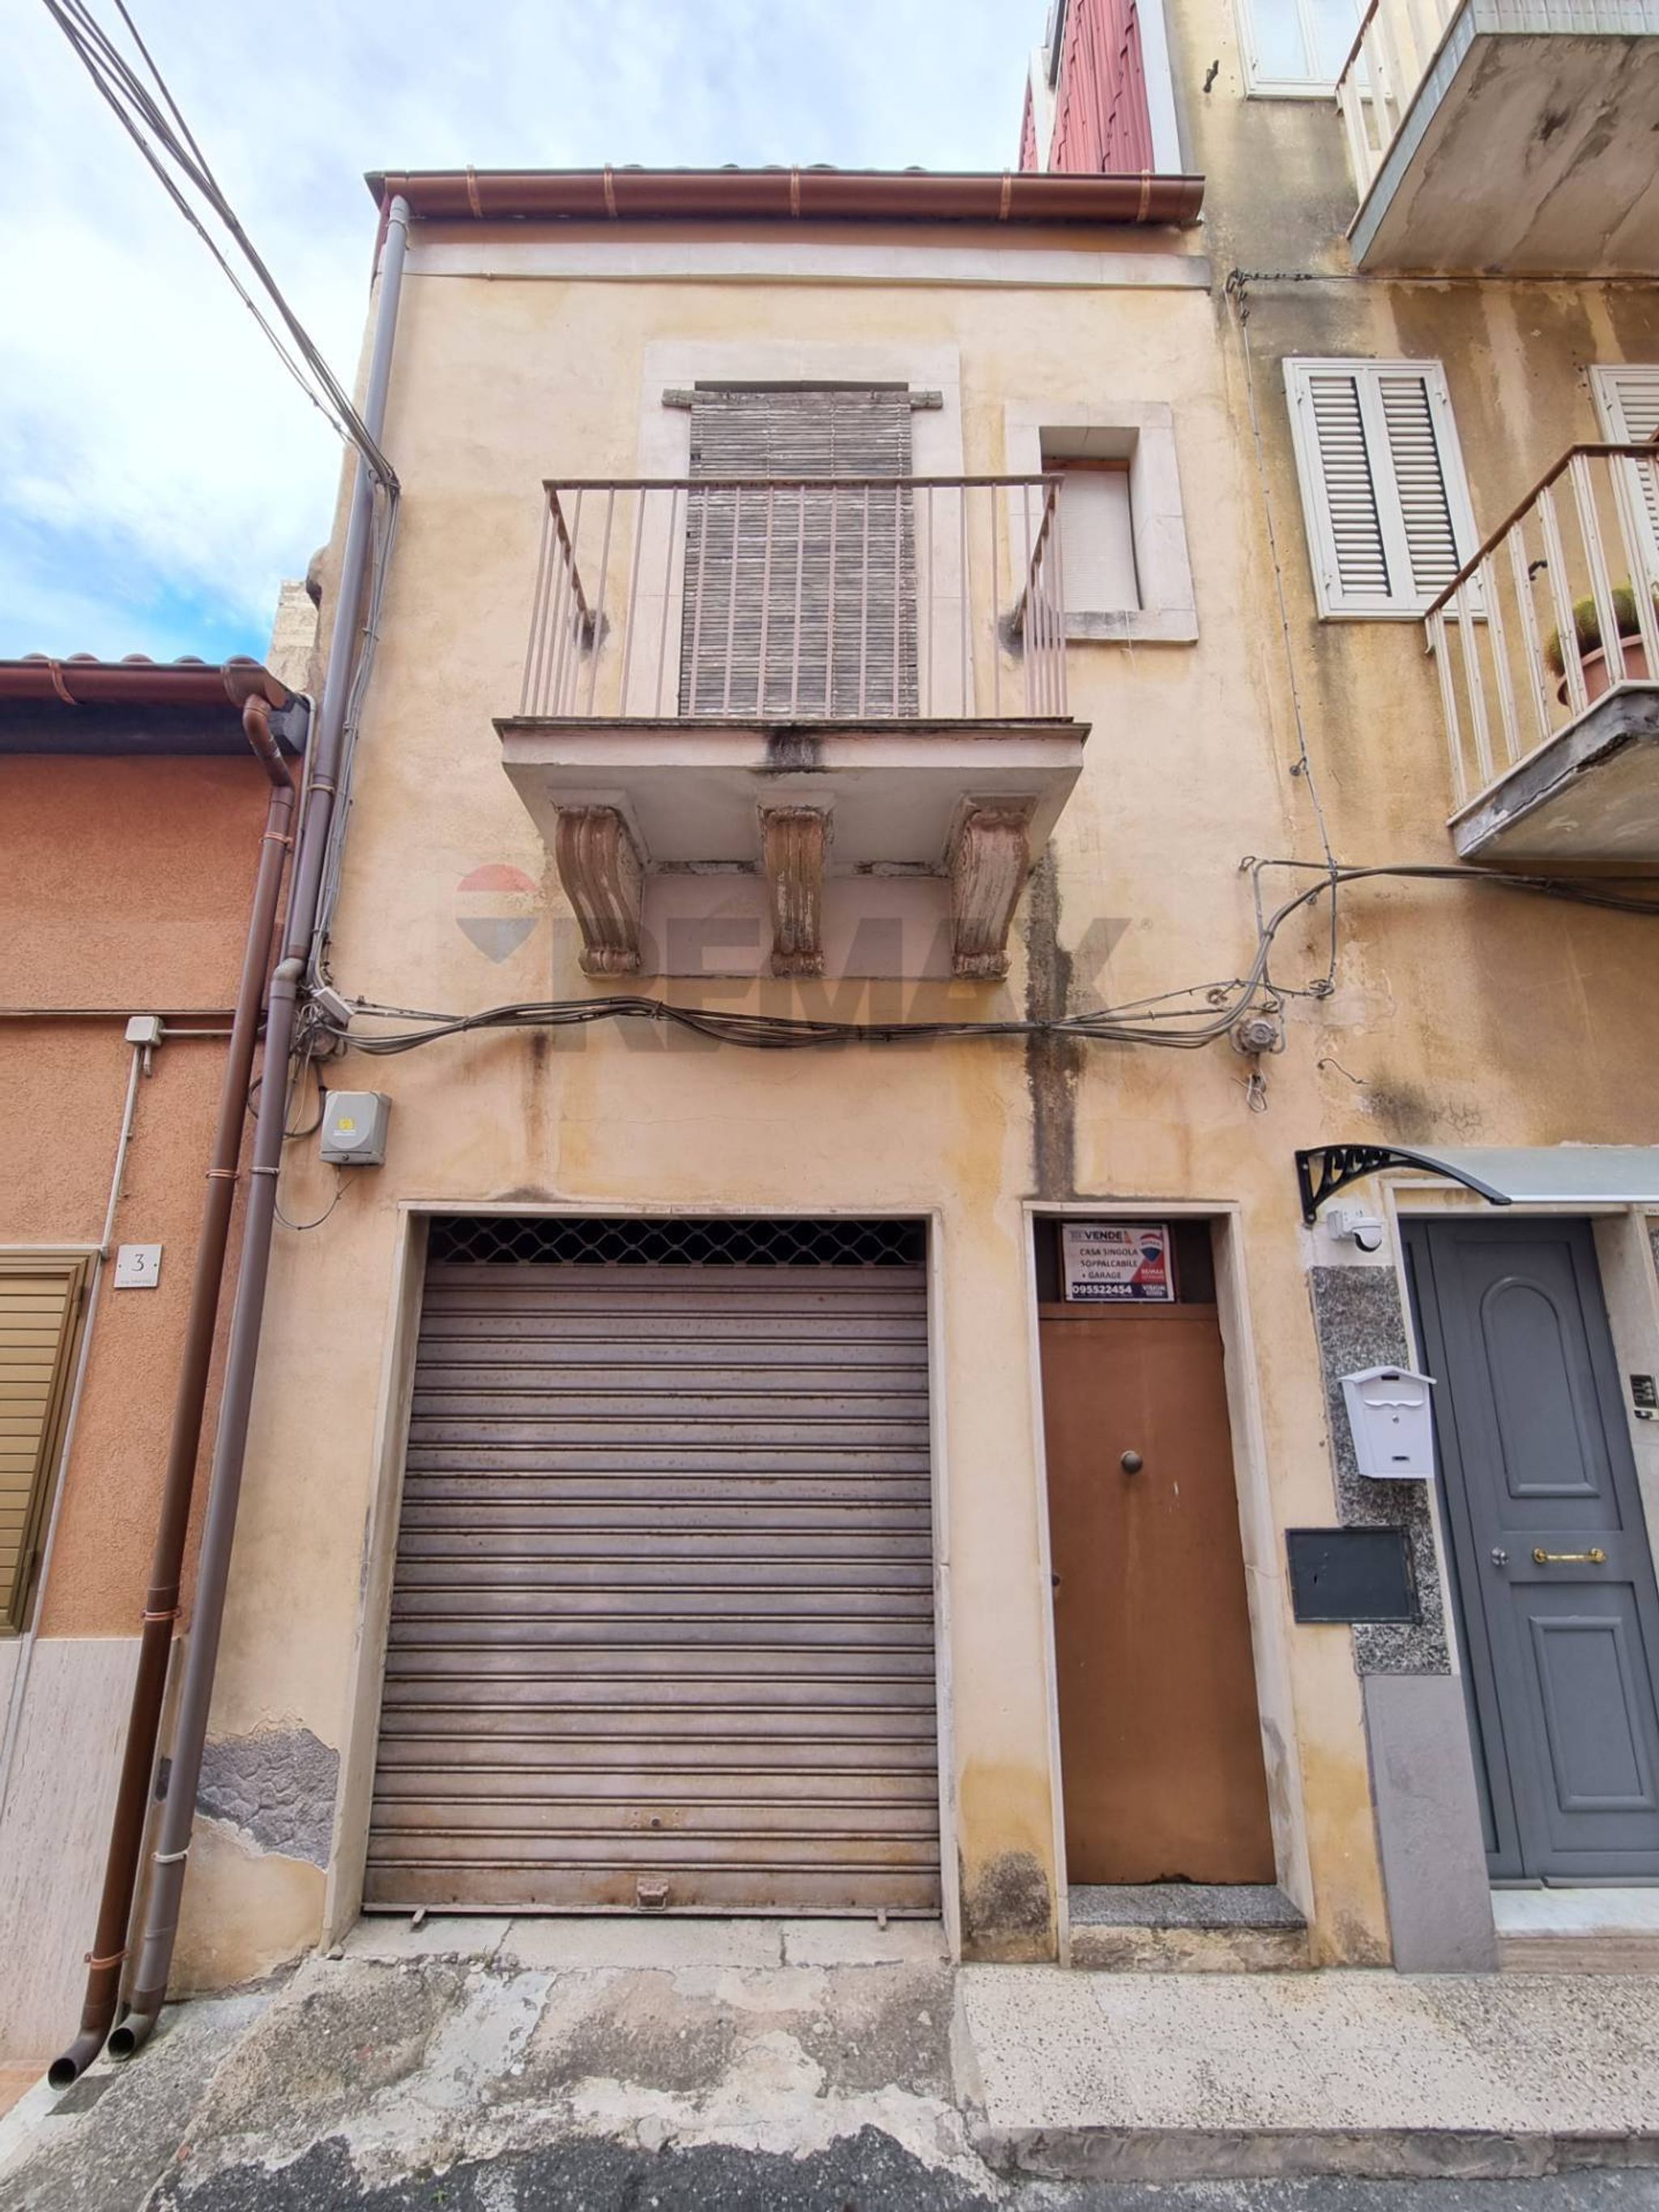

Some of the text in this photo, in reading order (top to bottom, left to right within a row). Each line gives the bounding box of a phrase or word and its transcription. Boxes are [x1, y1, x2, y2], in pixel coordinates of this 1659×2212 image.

[1085, 1230, 1122, 1240] VENDE
[131, 1253, 144, 1272] 3
[1081, 1260, 1137, 1268] SOPPALCABILE
